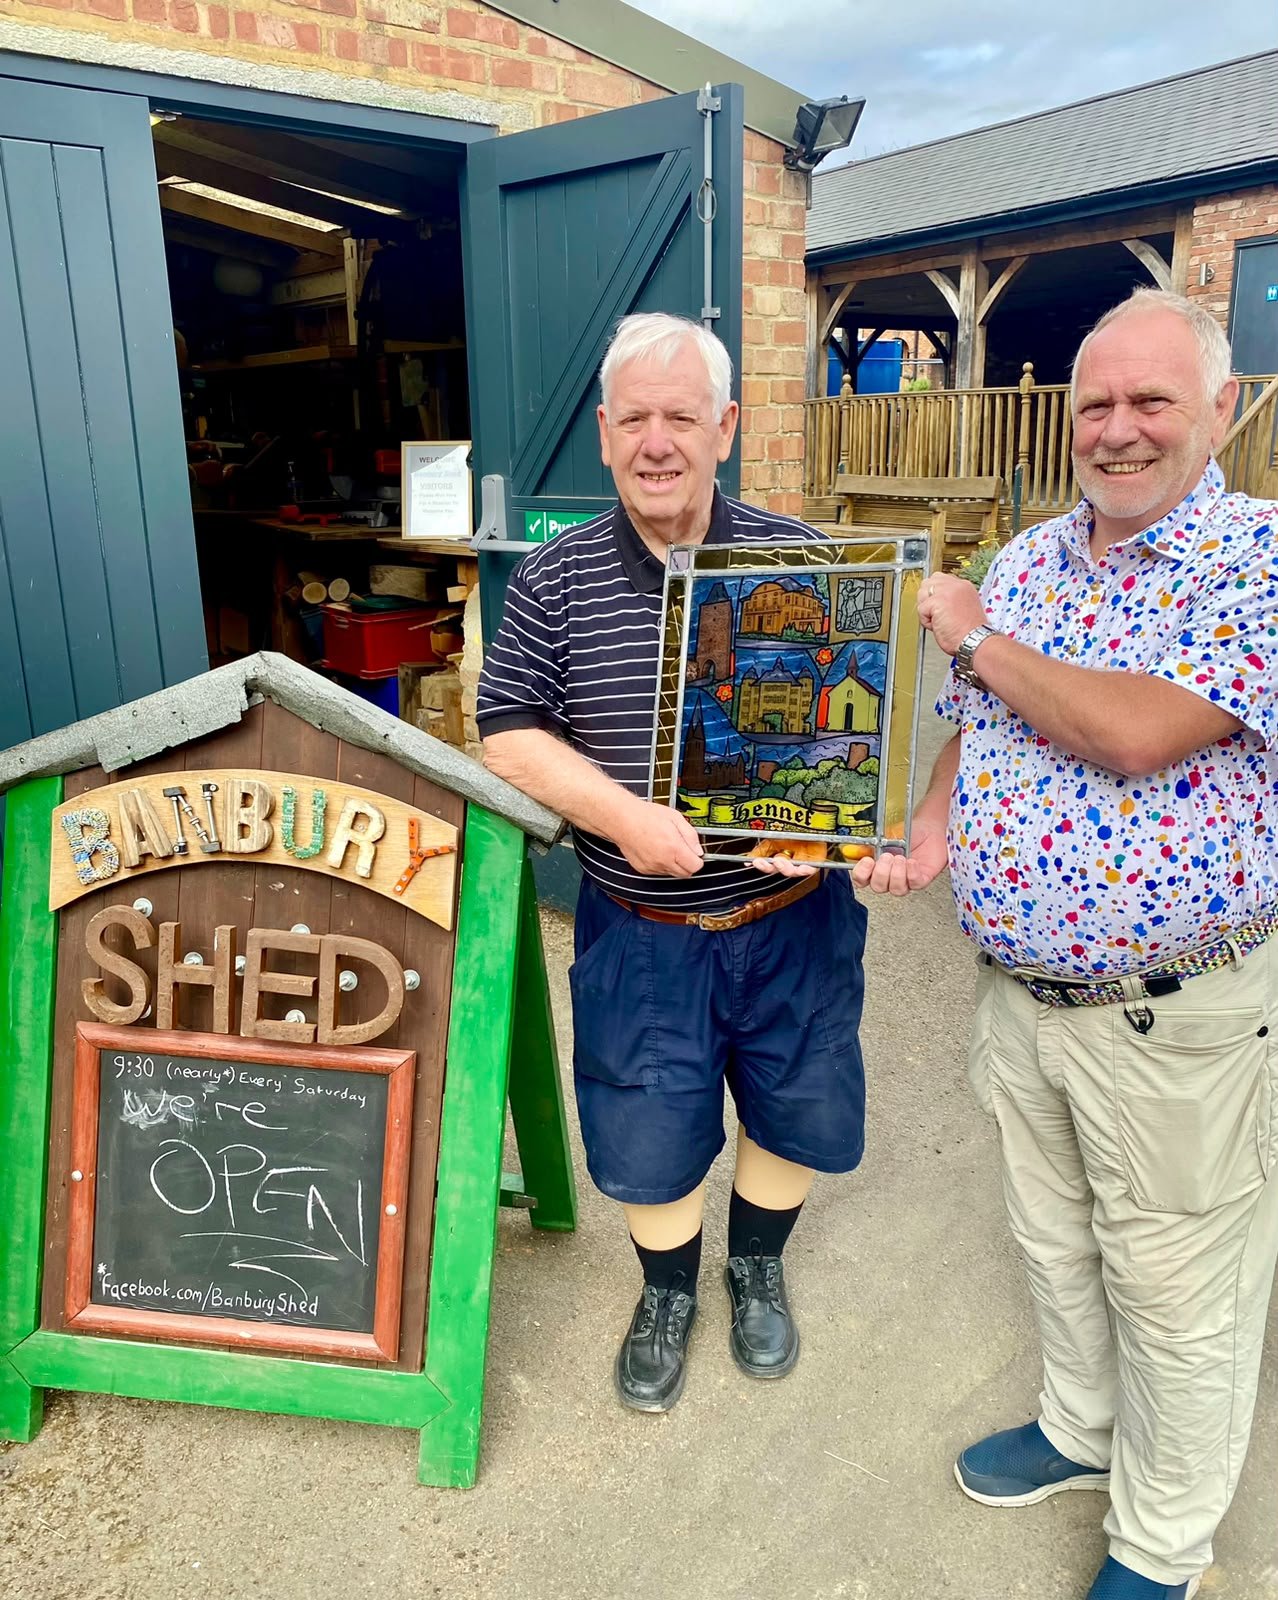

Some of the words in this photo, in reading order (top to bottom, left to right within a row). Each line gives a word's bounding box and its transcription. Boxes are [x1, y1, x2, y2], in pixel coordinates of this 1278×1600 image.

[548, 519, 577, 535] Pu
[61, 779, 457, 896] BANBURY
[81, 904, 405, 1046] SHED
[113, 1055, 155, 1079] 9:30
[239, 1071, 282, 1093] Every
[294, 1077, 367, 1108] Saturday
[150, 1138, 368, 1267] OPEN
